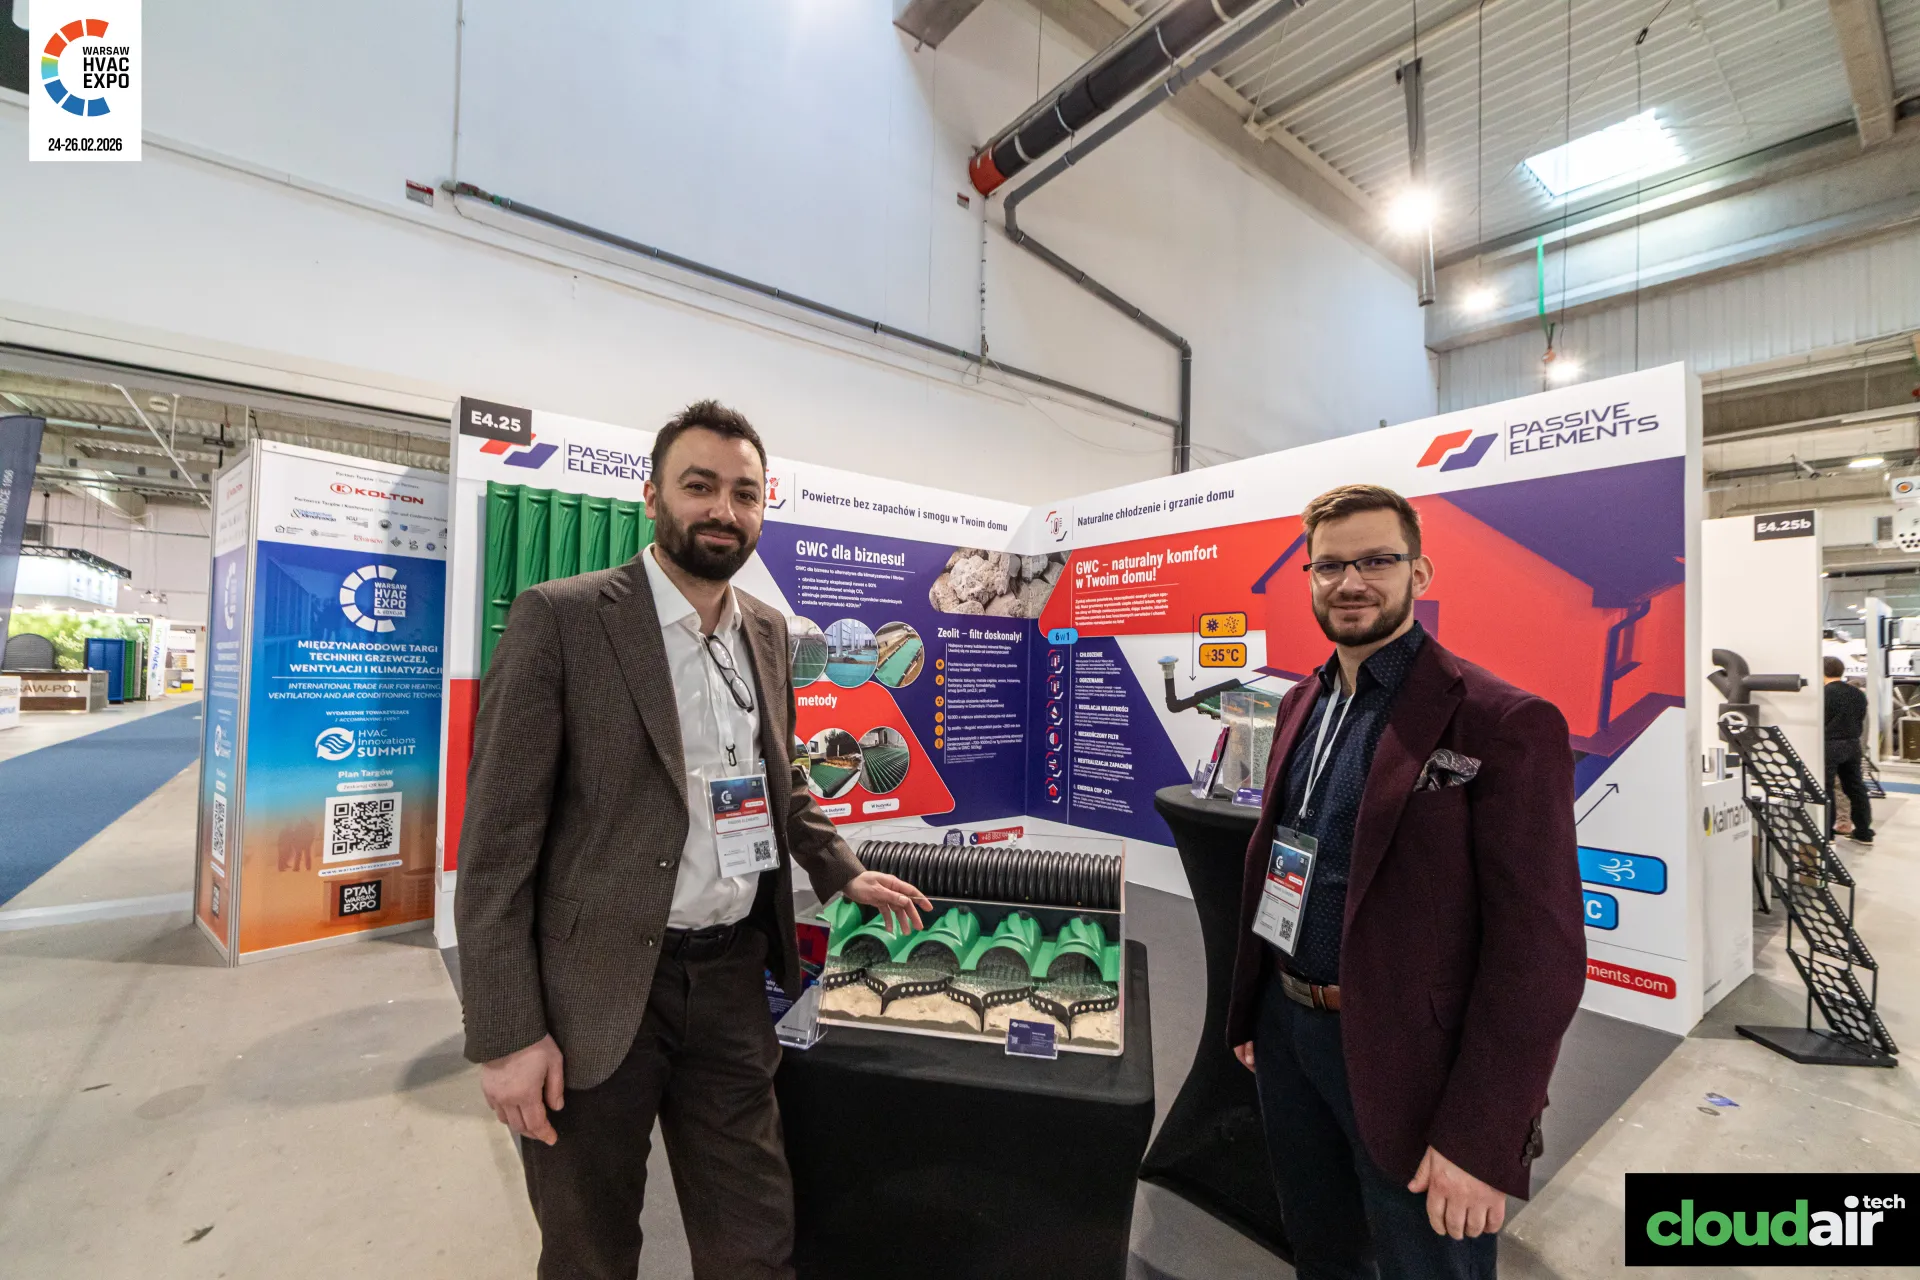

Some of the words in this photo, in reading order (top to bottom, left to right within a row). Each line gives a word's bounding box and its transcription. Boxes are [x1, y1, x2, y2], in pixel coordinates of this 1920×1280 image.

[471, 410, 521, 432] E4.25
[1510, 402, 1629, 439] PASSIVE
[1510, 414, 1659, 456] ELEMENTS
[802, 489, 851, 507] Powietrze
[853, 499, 870, 511] bez
[872, 501, 915, 518] zapachów
[923, 510, 950, 524] smogu
[952, 516, 959, 524] w
[961, 515, 986, 529] Twoim
[987, 519, 1008, 532] domu
[1077, 512, 1114, 527] Naturalne
[1115, 501, 1161, 520] chłodzenie
[1169, 494, 1204, 513] grzanie
[1206, 489, 1235, 503] domu
[1756, 518, 1811, 533] E4.25b
[796, 539, 828, 558] GWC
[831, 544, 851, 561] dla
[854, 547, 905, 567] biznesu!
[1076, 559, 1100, 575] GWC
[1111, 551, 1163, 571] naturalny
[1166, 544, 1218, 564] komfort
[1075, 578, 1084, 589] w
[1086, 573, 1119, 588] Twoim
[1122, 568, 1157, 584] domu!
[374, 582, 407, 591] WARSAW
[374, 589, 407, 600] HVAC
[374, 599, 406, 609] EXPO
[937, 627, 960, 639] Zeolit
[969, 629, 983, 640] filtr
[297, 640, 407, 653] MIĘDZYNARODOWE
[409, 644, 438, 653] TARGI
[309, 652, 362, 663] TECHNIKI
[364, 654, 428, 664] GRZEWCZEJ,
[290, 664, 362, 674] WENTYLACJI
[370, 665, 443, 675] KLIMATYZACJI
[288, 682, 351, 690] INTERNATIONAL
[268, 691, 320, 700] VENTILATION
[322, 691, 341, 699] AND
[356, 691, 411, 699] CONDITIONING
[798, 693, 838, 709] metody
[358, 728, 388, 738] HVAC
[358, 737, 416, 746] Innovations
[357, 745, 416, 758] SUMMIT
[338, 770, 359, 778] Plan
[361, 769, 394, 777] Targów
[344, 884, 377, 899] PTAK
[343, 900, 377, 913] EXPO
